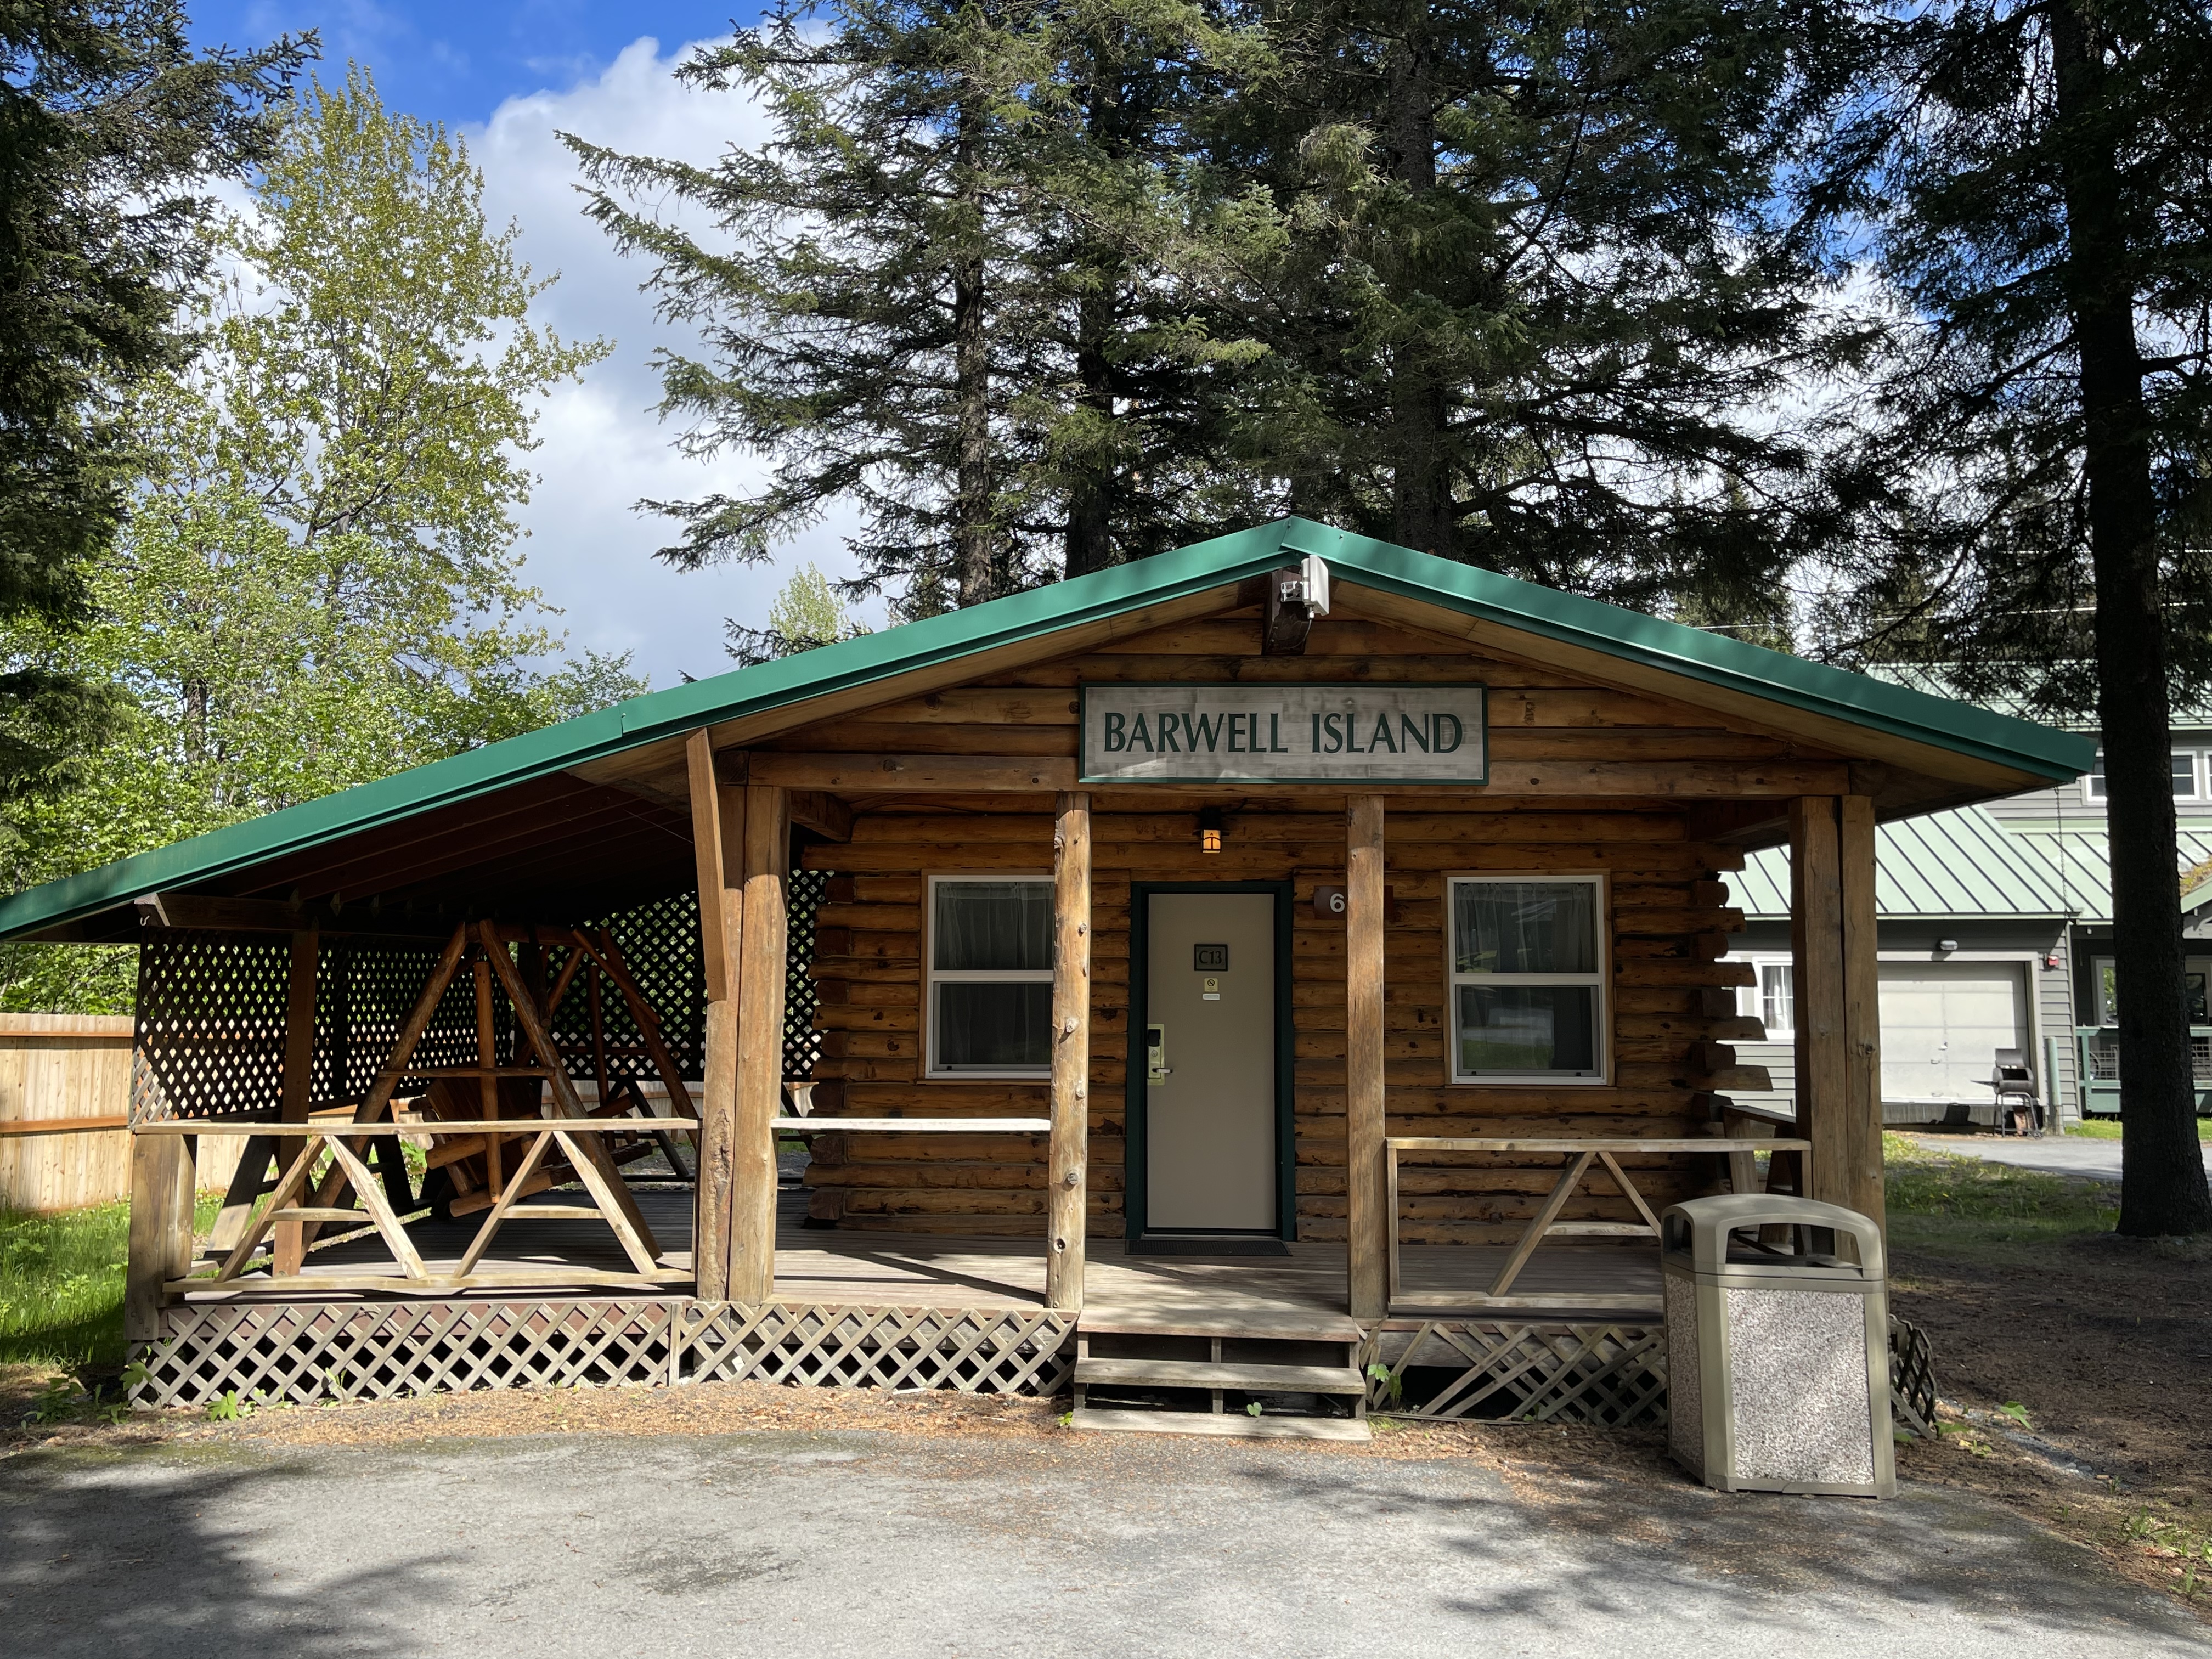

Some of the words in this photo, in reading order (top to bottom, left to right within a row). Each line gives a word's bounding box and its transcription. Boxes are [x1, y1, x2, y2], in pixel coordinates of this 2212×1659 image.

[1104, 712, 1289, 753] BARWELL
[1312, 713, 1463, 754] ISLAND
[1330, 893, 1345, 913] 6
[1198, 950, 1222, 964] C13
